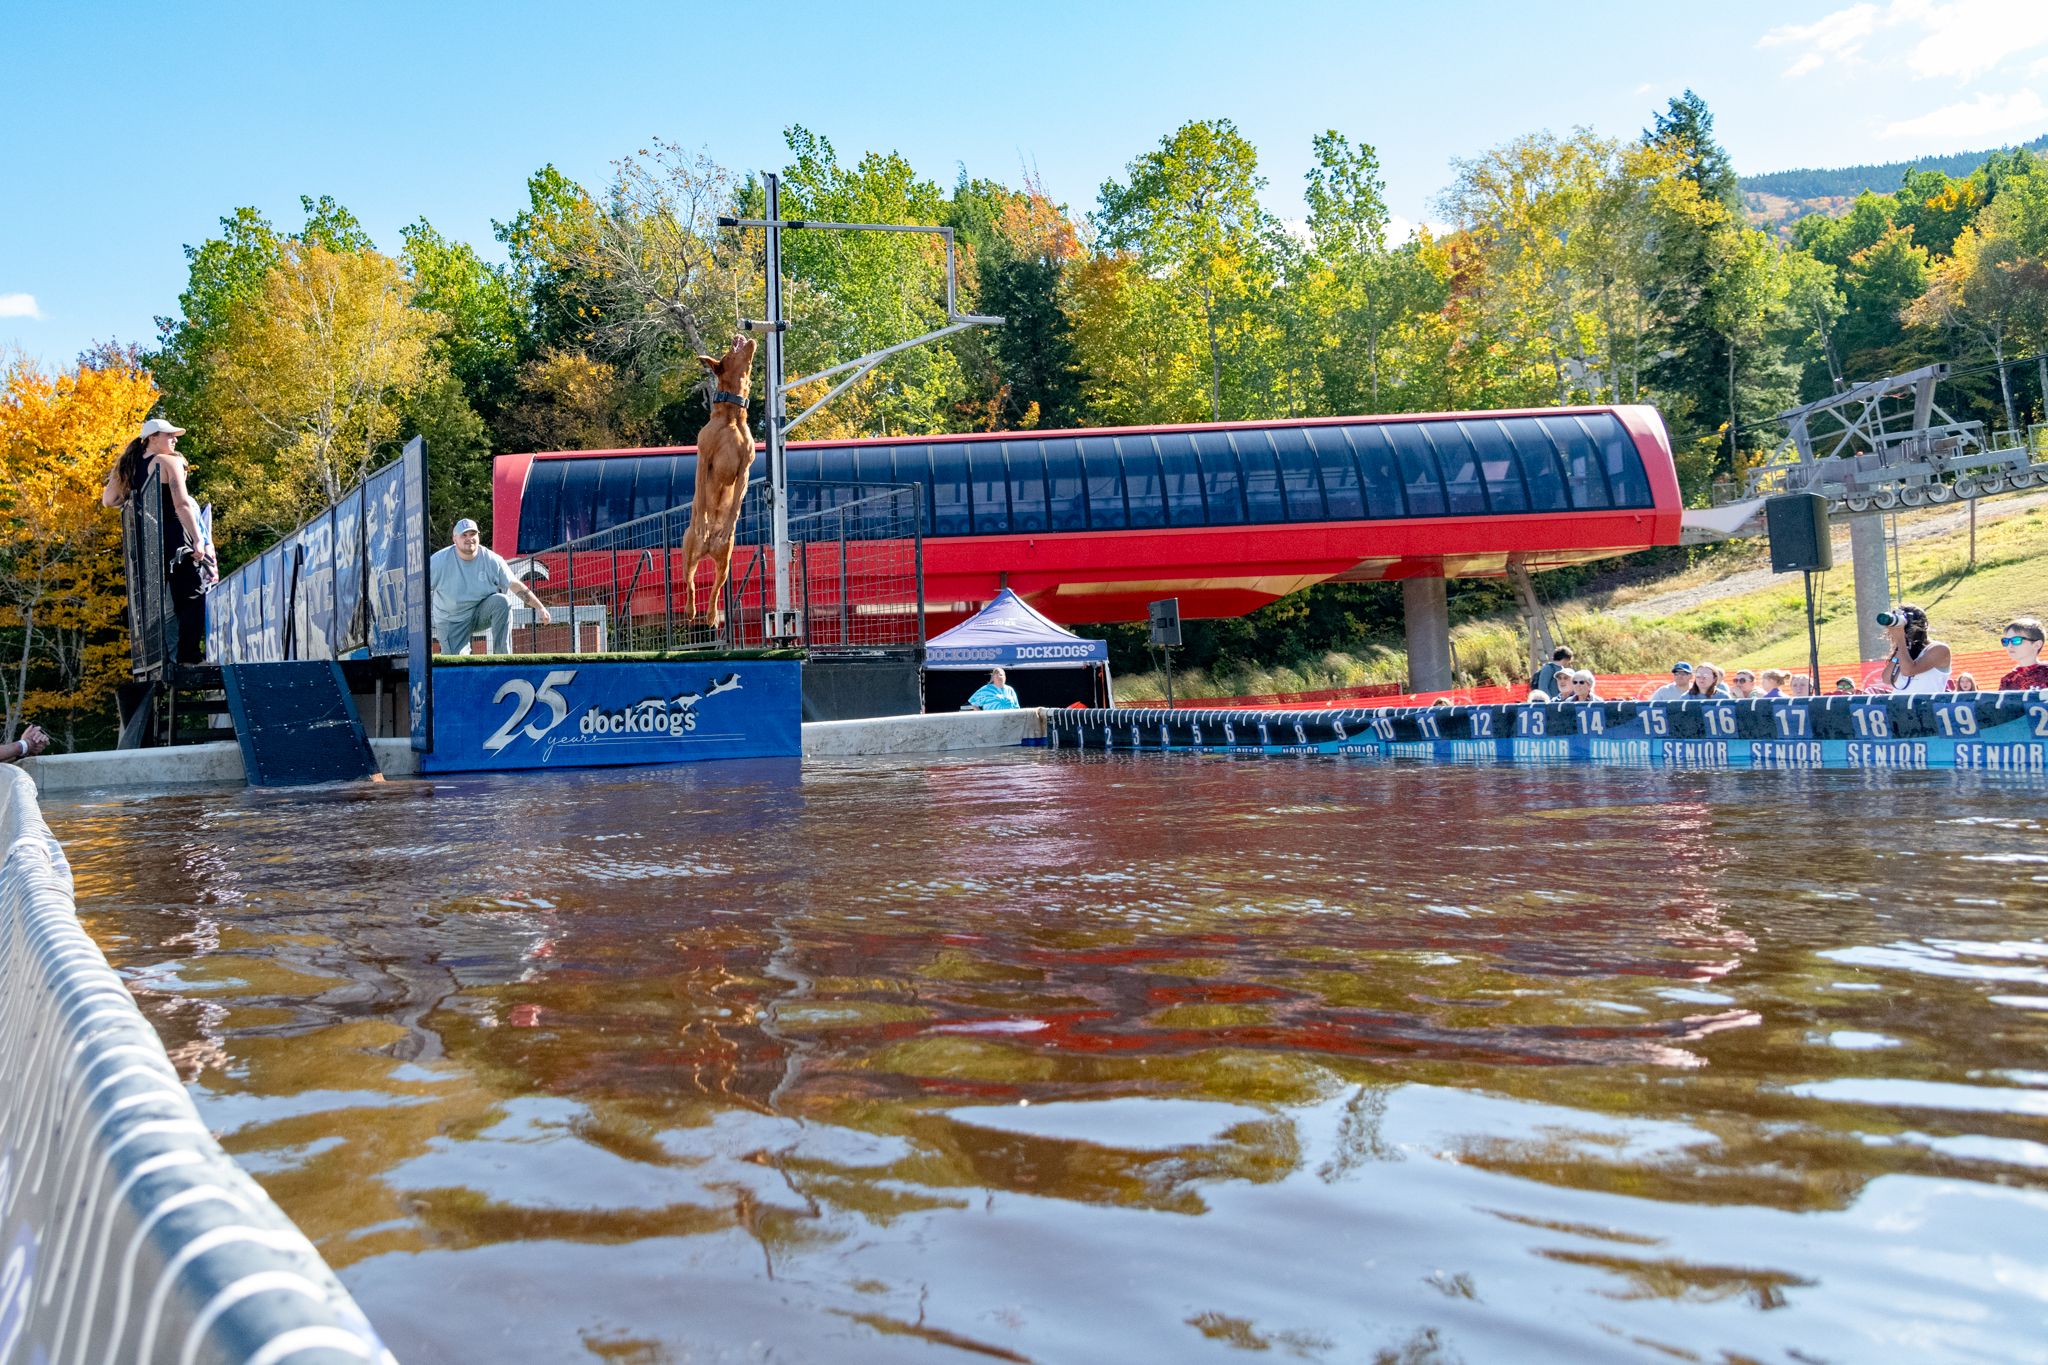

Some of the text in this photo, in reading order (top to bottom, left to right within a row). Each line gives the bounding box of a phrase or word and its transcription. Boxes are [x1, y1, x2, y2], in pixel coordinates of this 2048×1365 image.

[483, 670, 578, 751] 25
[1078, 728, 1084, 747] 1
[1104, 727, 1112, 745] 2
[1132, 727, 1140, 745] 3
[1162, 727, 1169, 745] 4
[1192, 725, 1202, 743] 5
[1224, 723, 1235, 742] 6
[1258, 724, 1268, 743] 7
[1294, 724, 1306, 744] 8
[1333, 721, 1347, 740] 9
[1371, 718, 1395, 740] 10
[1417, 716, 1439, 738] 11
[1470, 712, 1491, 736] 12
[1518, 710, 1545, 736] 13
[1577, 710, 1604, 735] 14
[1638, 709, 1667, 735] 15
[1704, 707, 1736, 736] 16
[1775, 708, 1806, 736] 17
[1852, 708, 1888, 737] 18
[1935, 705, 1977, 736] 19
[543, 734, 600, 762] years
[1453, 741, 1497, 756] JUNIOR
[1513, 739, 1569, 757] JUNIOR
[1591, 740, 1649, 758] JUNIOR
[1663, 741, 1727, 758] SENIOR
[1751, 742, 1822, 761] SENIOR
[1848, 742, 1927, 763] SENIOR
[1956, 743, 2043, 765] SENIOR
